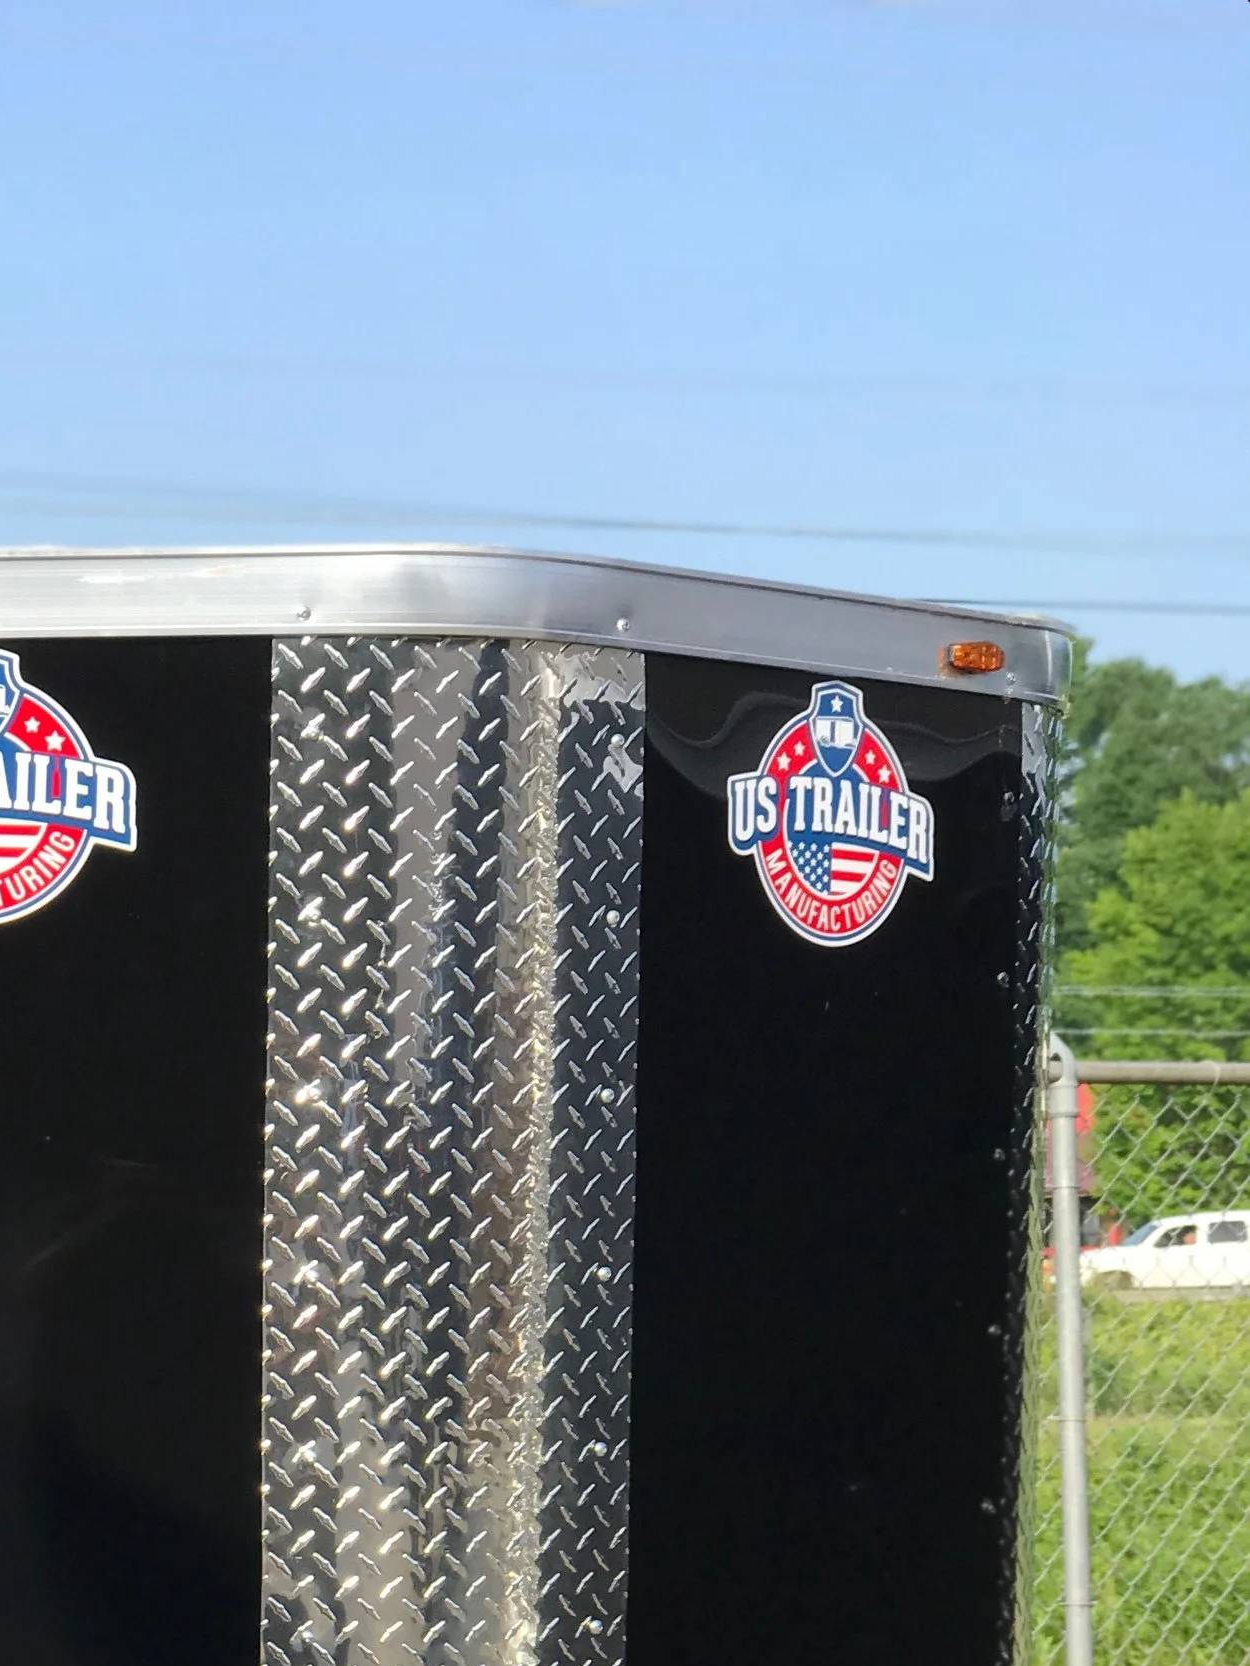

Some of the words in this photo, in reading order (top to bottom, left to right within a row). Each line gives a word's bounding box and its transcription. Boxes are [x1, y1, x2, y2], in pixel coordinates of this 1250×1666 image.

[734, 775, 778, 841] US
[789, 776, 928, 865] TRAILER
[765, 848, 897, 932] MANUFACTURING
